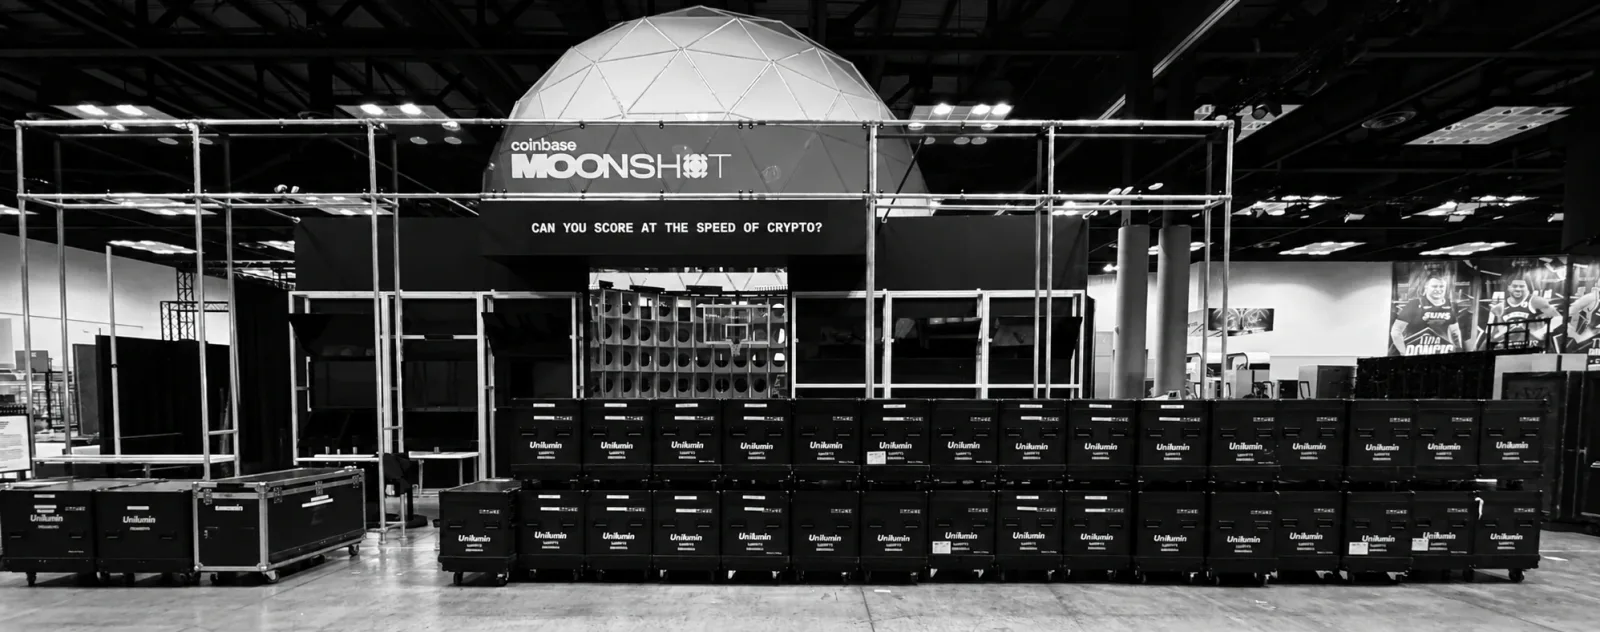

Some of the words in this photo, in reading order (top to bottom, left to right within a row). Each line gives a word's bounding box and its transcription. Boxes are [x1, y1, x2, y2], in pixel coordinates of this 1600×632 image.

[511, 138, 577, 151] coinbase
[532, 223, 555, 233] CAN
[563, 223, 586, 233] YOU
[594, 223, 633, 233] SCORE
[641, 223, 657, 232] AT
[665, 223, 688, 232] THE
[697, 222, 735, 232] SPEED
[744, 223, 759, 232] OF
[767, 222, 822, 232] CRYPTO?
[810, 441, 842, 449] Unilumin
[1229, 442, 1263, 450] Unilumin
[1496, 441, 1528, 449] Unilumin
[30, 514, 63, 522] Unilumin
[535, 531, 567, 539] Unilumin
[1290, 532, 1323, 540] Unilumin
[1362, 535, 1395, 543] Unilumin
[1423, 532, 1456, 540] Unilumin
